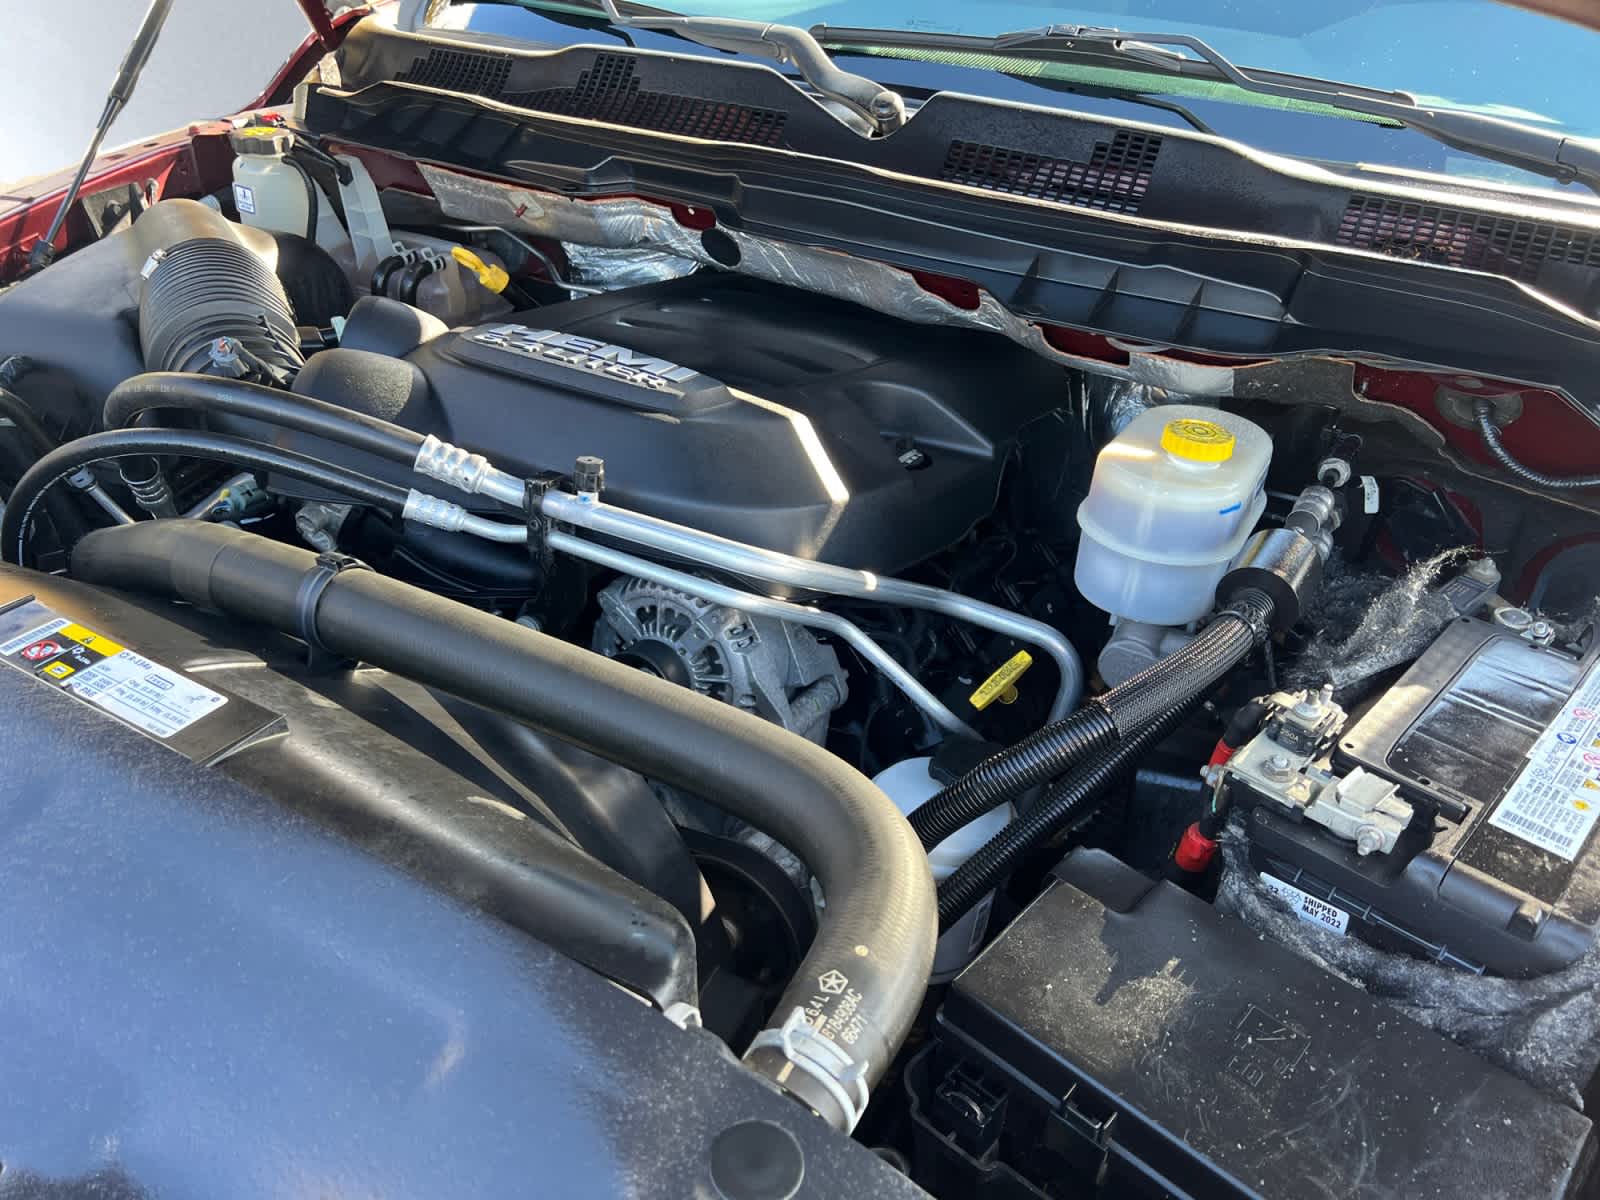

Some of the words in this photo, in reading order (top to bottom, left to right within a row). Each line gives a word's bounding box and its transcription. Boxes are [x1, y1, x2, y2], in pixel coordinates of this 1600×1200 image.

[487, 323, 700, 383] HEMI
[542, 348, 668, 388] LITER
[1302, 903, 1319, 917] MAY
[1321, 914, 1341, 928] 2022
[1303, 896, 1338, 917] SHIPPED
